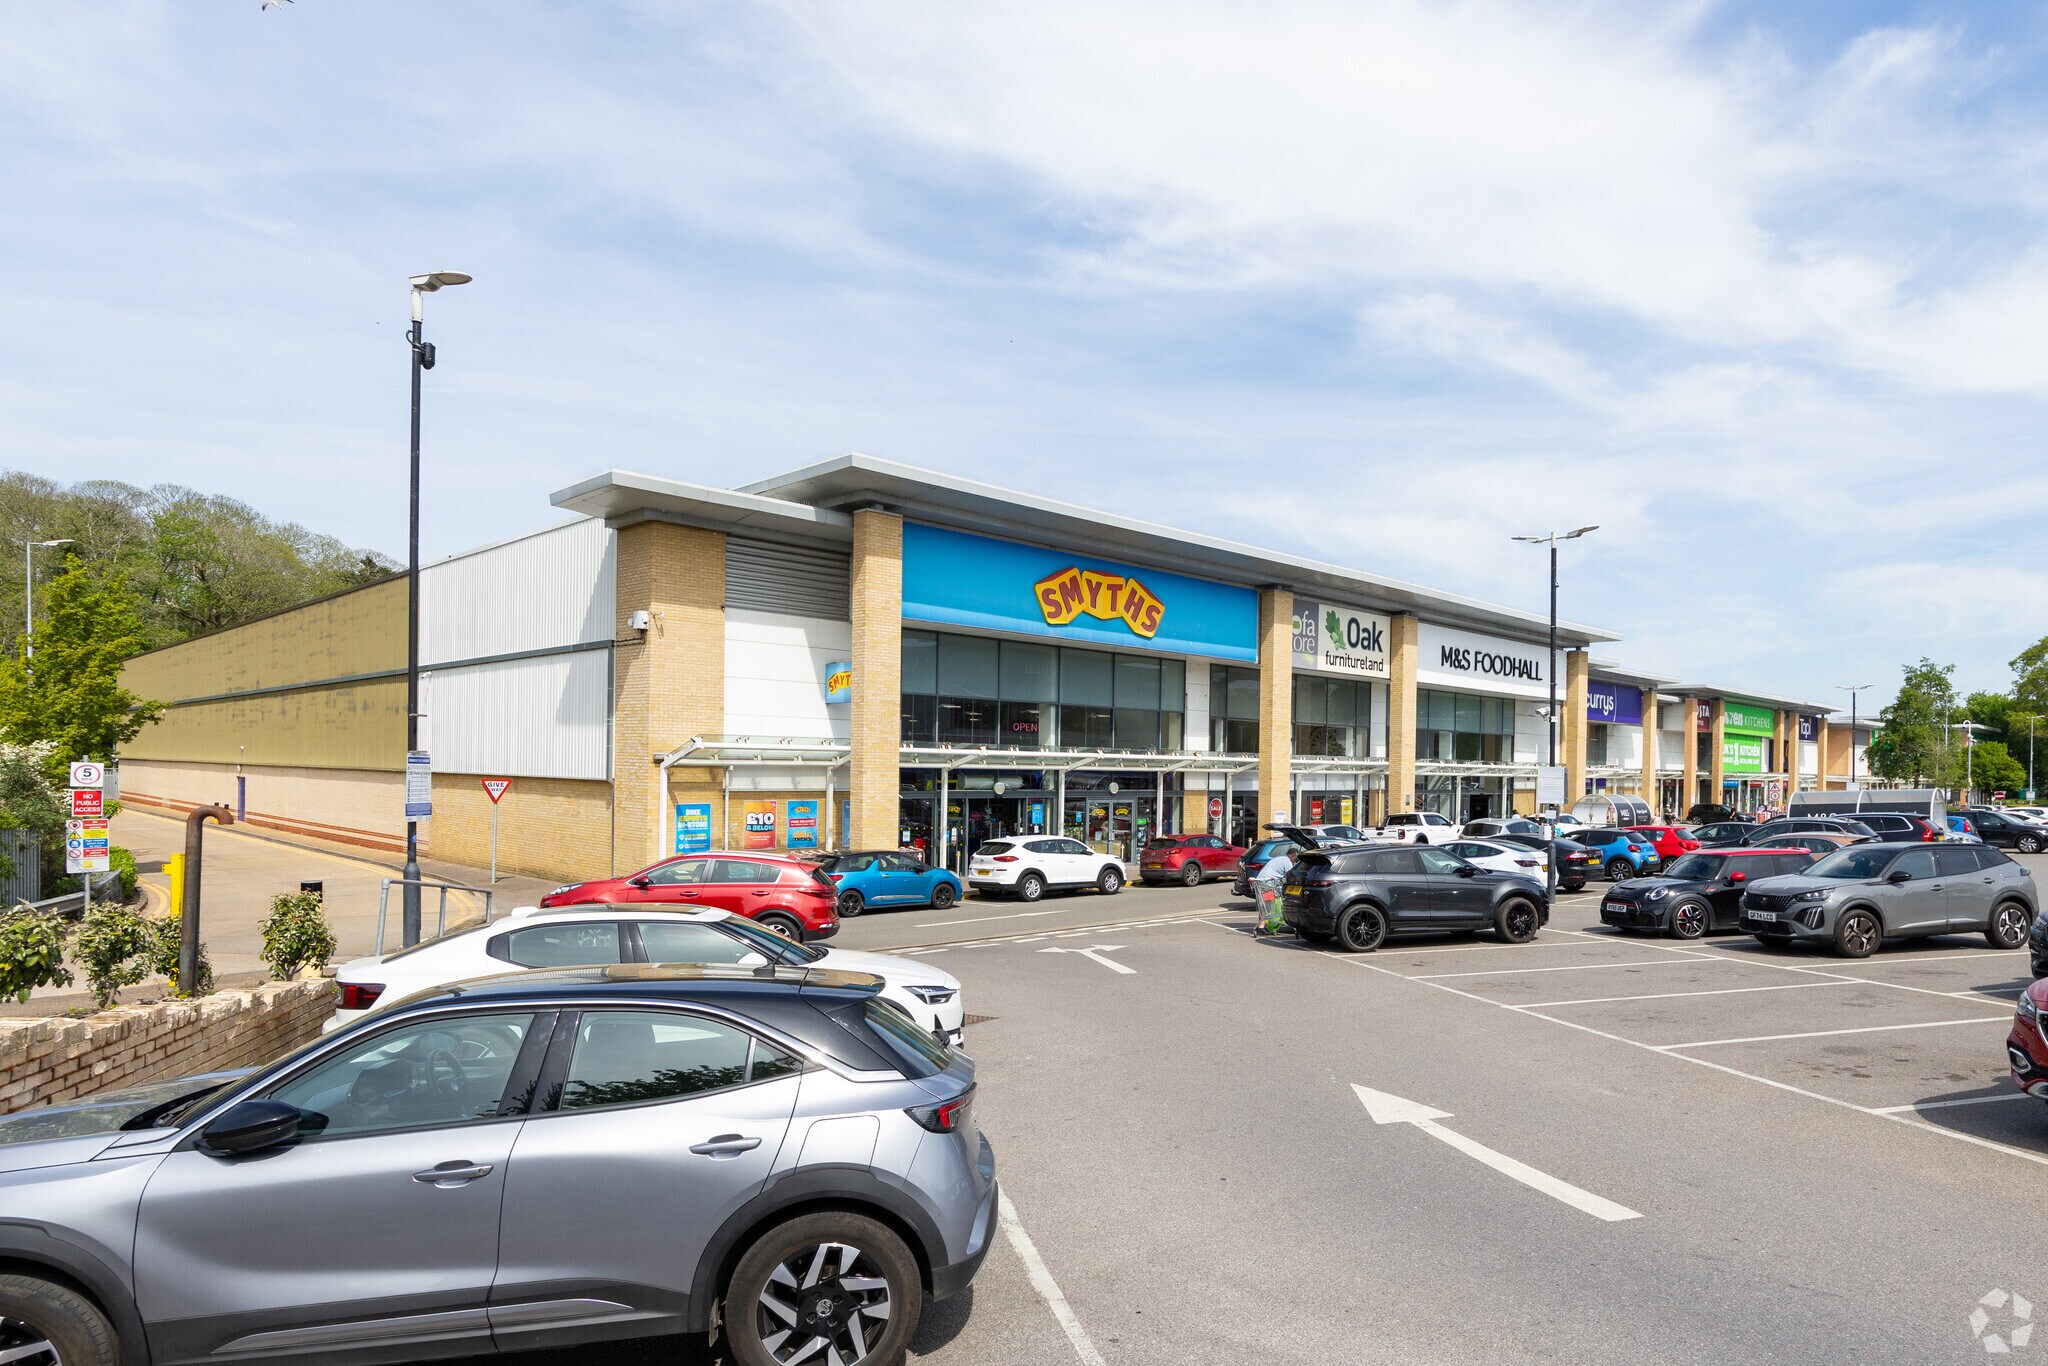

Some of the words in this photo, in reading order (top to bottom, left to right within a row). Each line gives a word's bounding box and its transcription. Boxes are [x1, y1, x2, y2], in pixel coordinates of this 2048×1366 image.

[1041, 574, 1162, 633] SMYTHS
[1292, 611, 1316, 636] ofa
[1347, 617, 1384, 653] Oak
[1292, 636, 1315, 653] ore
[1325, 650, 1384, 672] furnitureland
[1441, 645, 1471, 671] M&S
[1474, 651, 1543, 681] FOODHALL
[828, 674, 851, 692] SMYT
[1013, 722, 1038, 732] OPEN
[1744, 715, 1770, 729] KITCHENS
[1800, 717, 1812, 738] Tapi
[83, 768, 91, 777] 5
[678, 821, 708, 829] IN-STORE
[746, 812, 774, 825] £10
[1750, 911, 1762, 919] GF74
